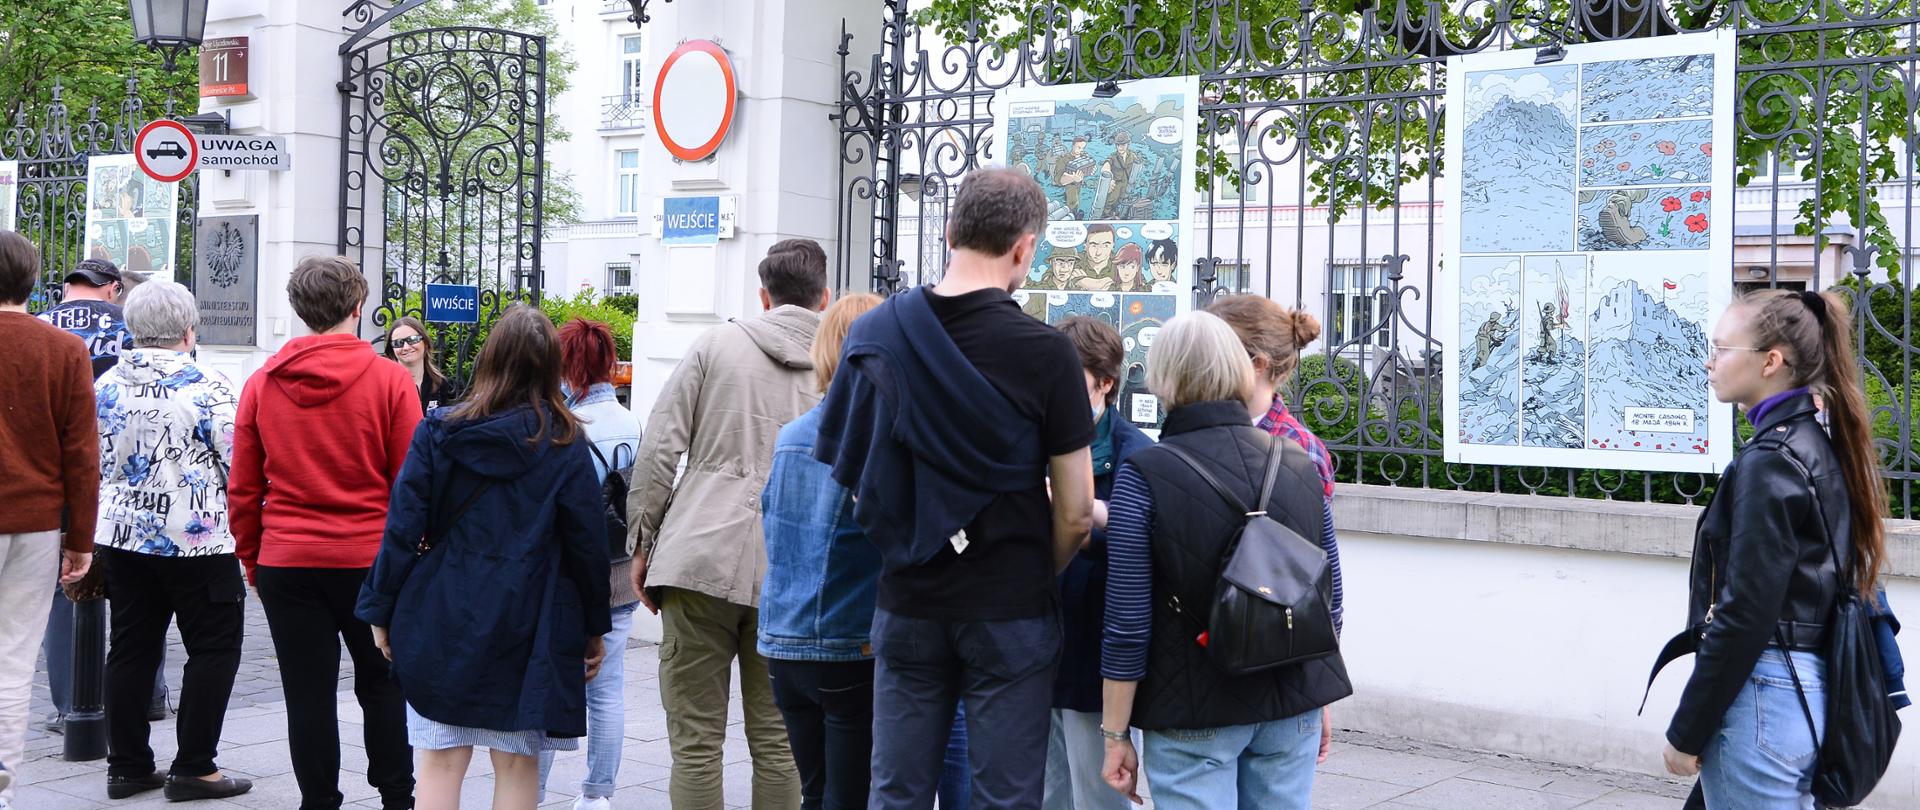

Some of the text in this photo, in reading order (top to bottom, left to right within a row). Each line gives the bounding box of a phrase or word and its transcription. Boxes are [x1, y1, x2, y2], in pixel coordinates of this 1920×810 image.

[212, 52, 228, 82] 11
[201, 139, 277, 151] UWAGA
[201, 154, 279, 165] samochód
[667, 210, 715, 229] WEJŚCIE
[431, 295, 475, 311] WYJŚCIE
[199, 314, 253, 327] PRAWIEDLIWOŚCI
